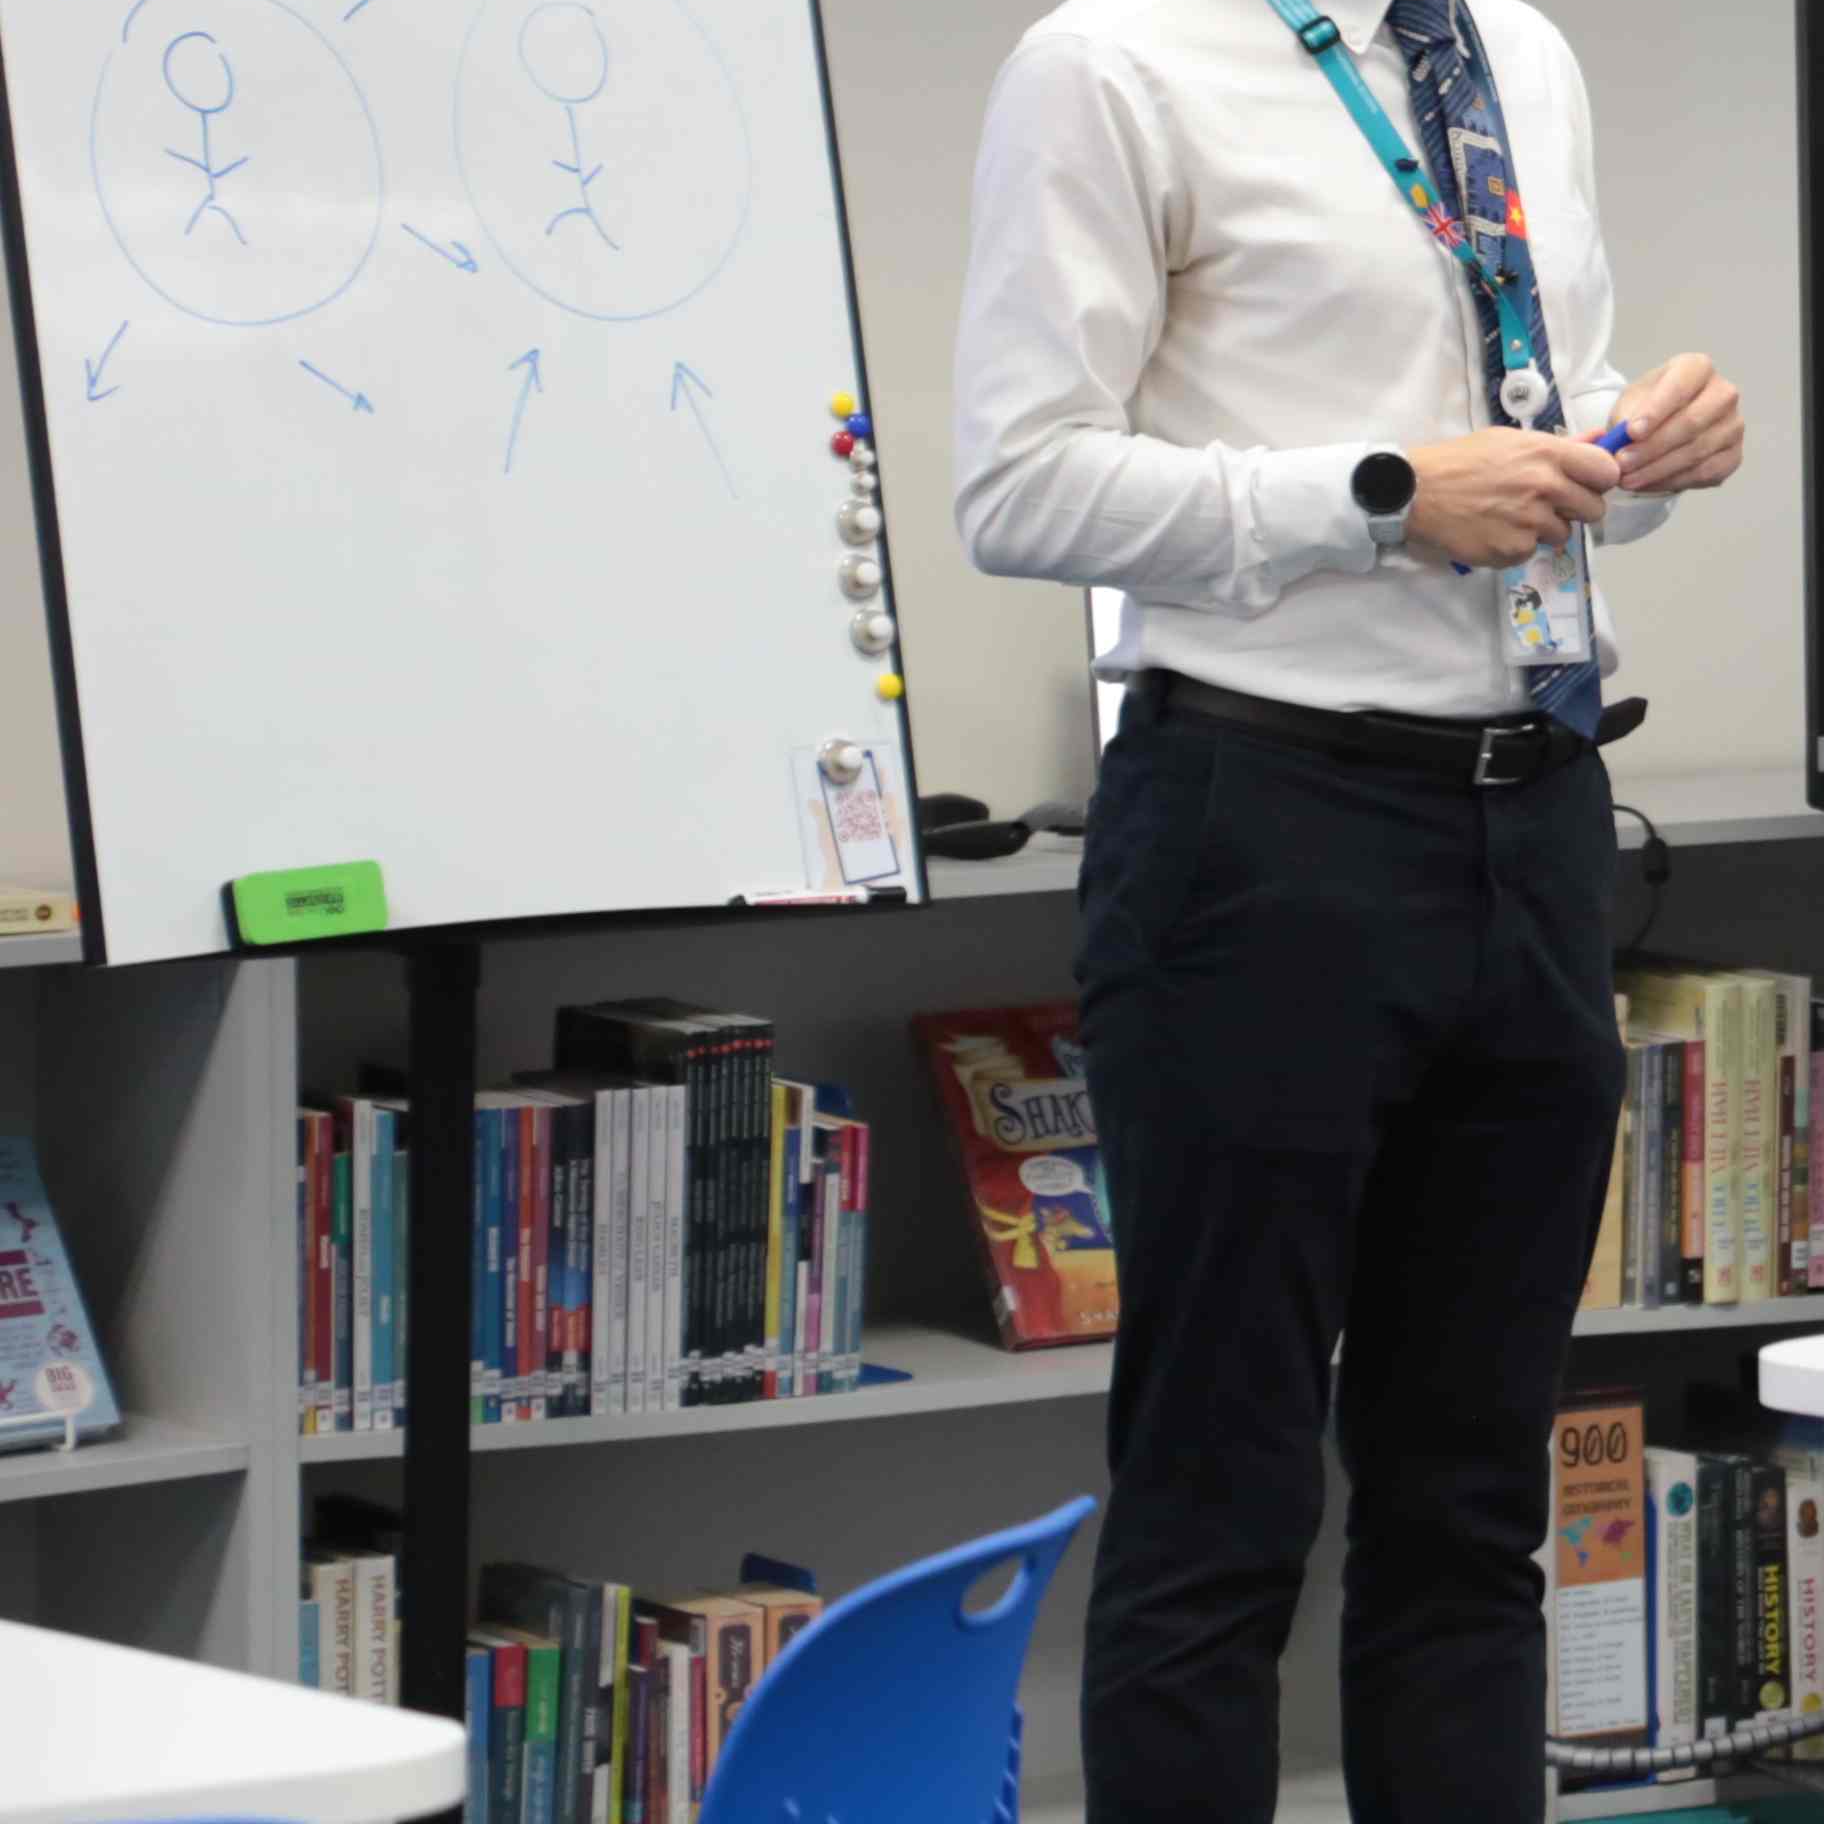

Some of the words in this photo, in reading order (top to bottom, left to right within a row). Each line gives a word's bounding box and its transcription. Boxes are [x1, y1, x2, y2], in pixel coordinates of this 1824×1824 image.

[1561, 1421, 1627, 1468] 900
[336, 1577, 352, 1646] HARRY
[371, 1574, 387, 1642] HARRY
[1763, 1563, 1782, 1676] HISTORY
[1802, 1578, 1817, 1682] HISTORY
